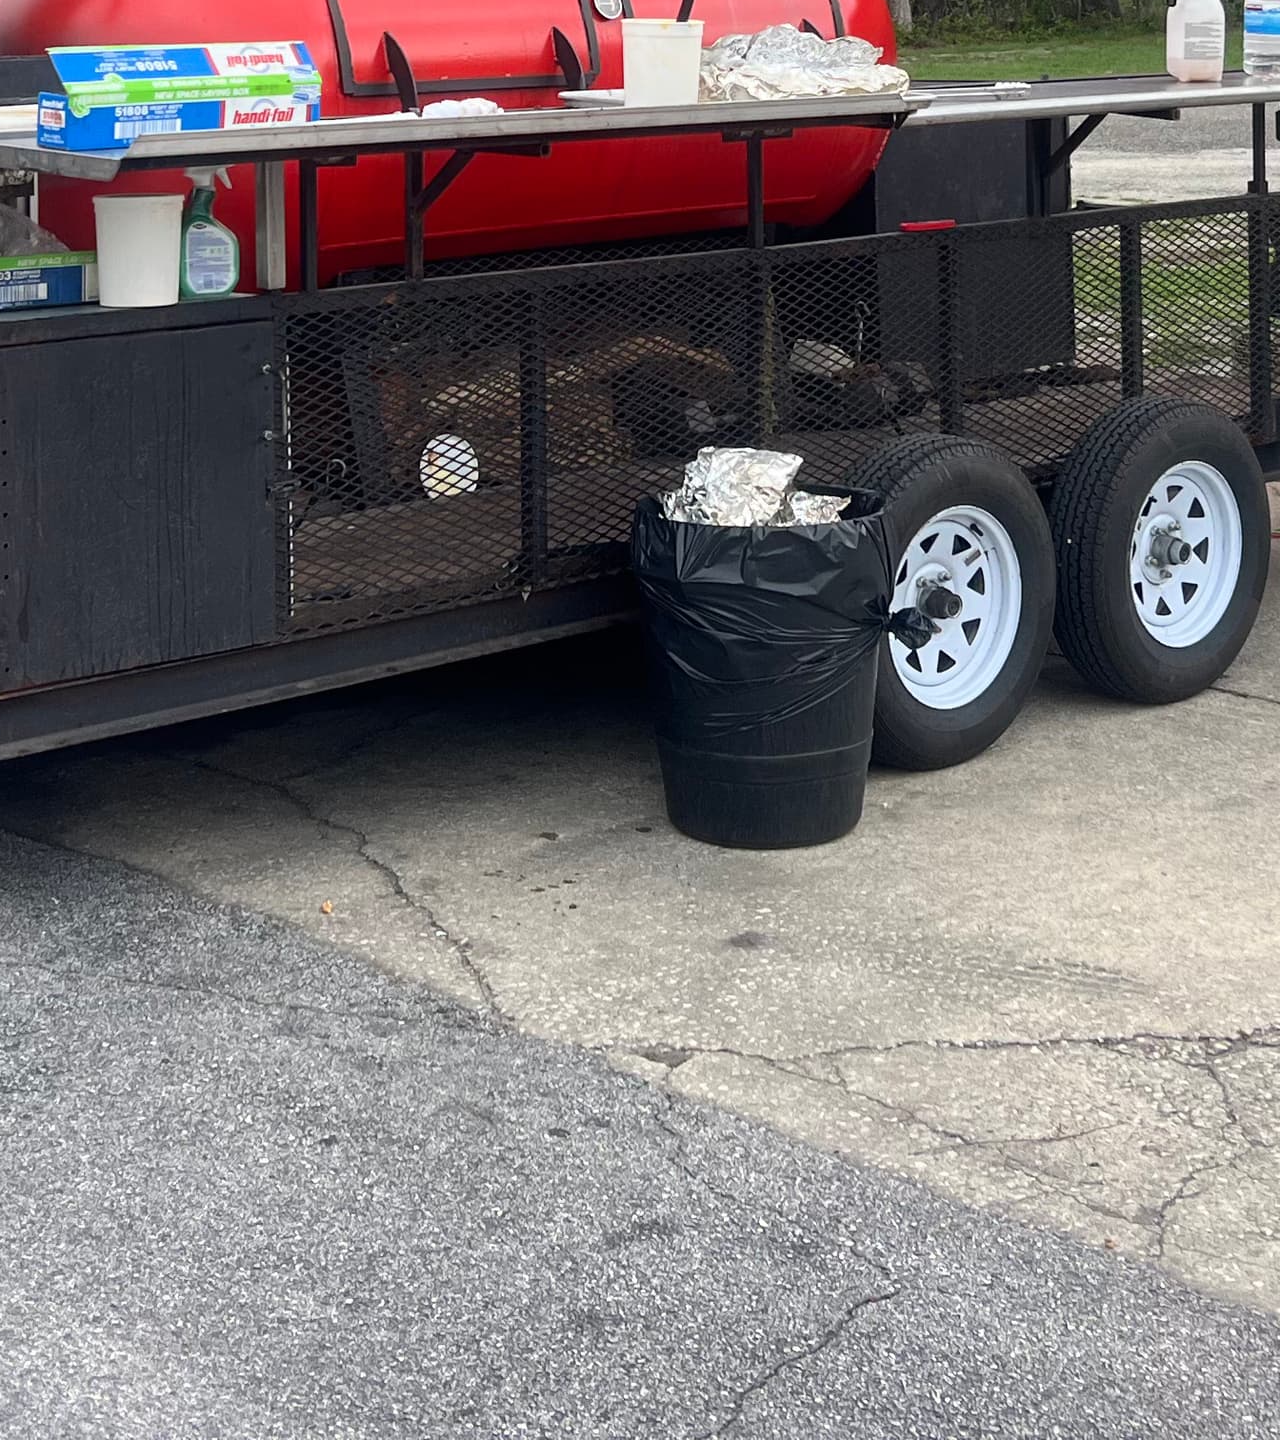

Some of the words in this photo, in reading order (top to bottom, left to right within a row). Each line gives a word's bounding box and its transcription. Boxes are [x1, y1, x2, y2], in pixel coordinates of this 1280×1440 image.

[135, 60, 178, 72] 51808
[153, 91, 175, 100] NEW
[232, 87, 250, 96] BOX
[114, 105, 149, 117] 51808
[17, 259, 37, 267] NEW
